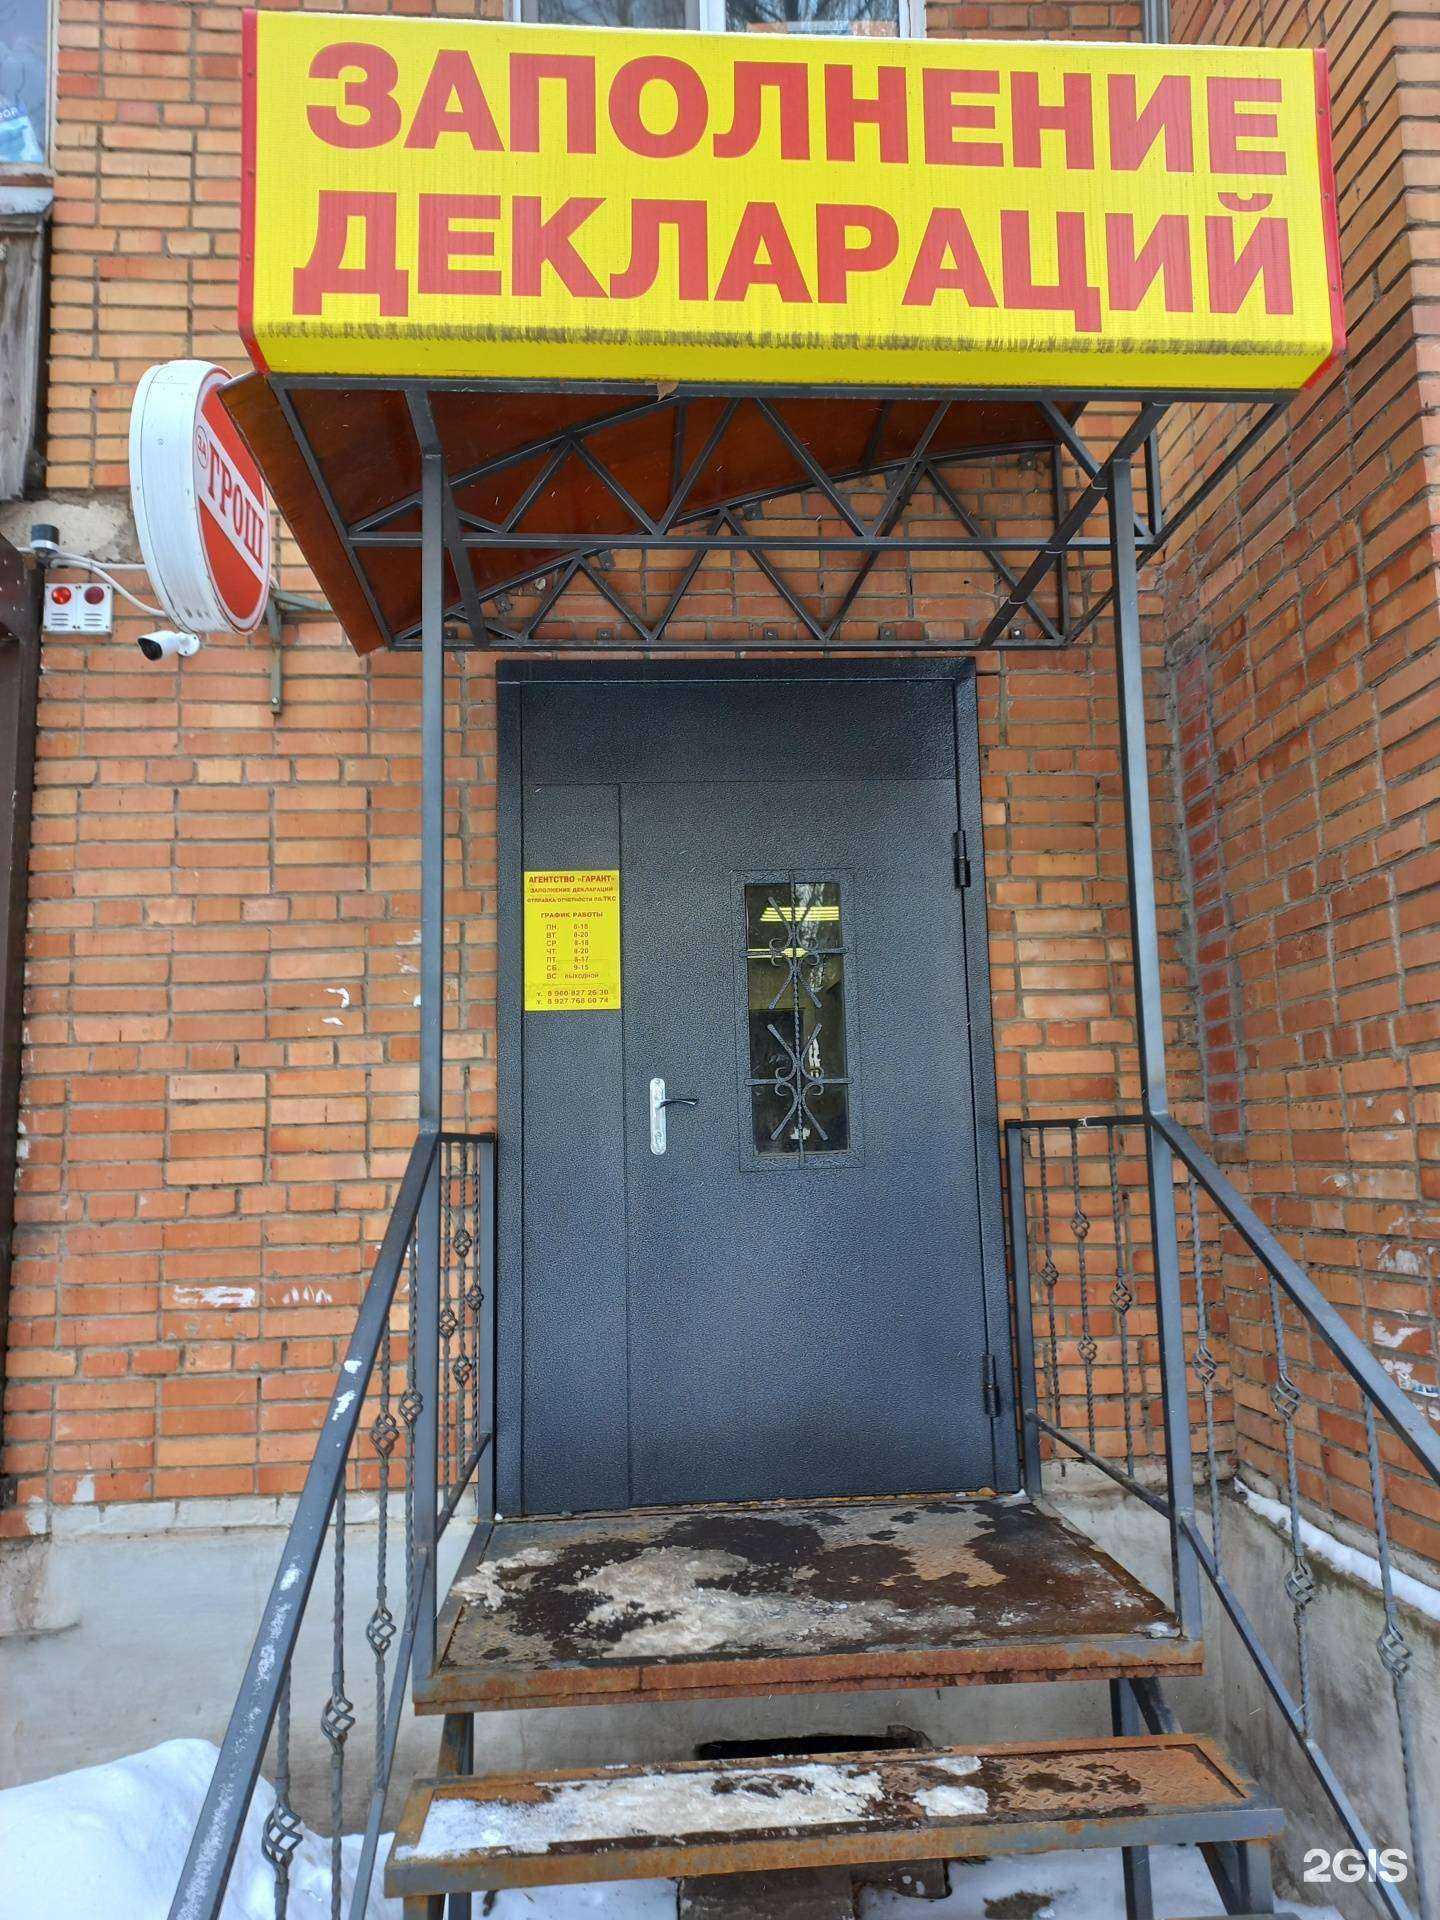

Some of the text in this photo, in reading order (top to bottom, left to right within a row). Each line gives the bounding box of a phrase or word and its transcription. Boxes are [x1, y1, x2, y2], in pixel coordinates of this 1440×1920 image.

[305, 41, 1287, 176] ЗАПОЛНЕНИЕ
[292, 189, 1294, 333] ДЕКЛАРАЦИЙ
[206, 441, 265, 569] ГРОШ
[528, 875, 575, 883] АГЕНТСТВО
